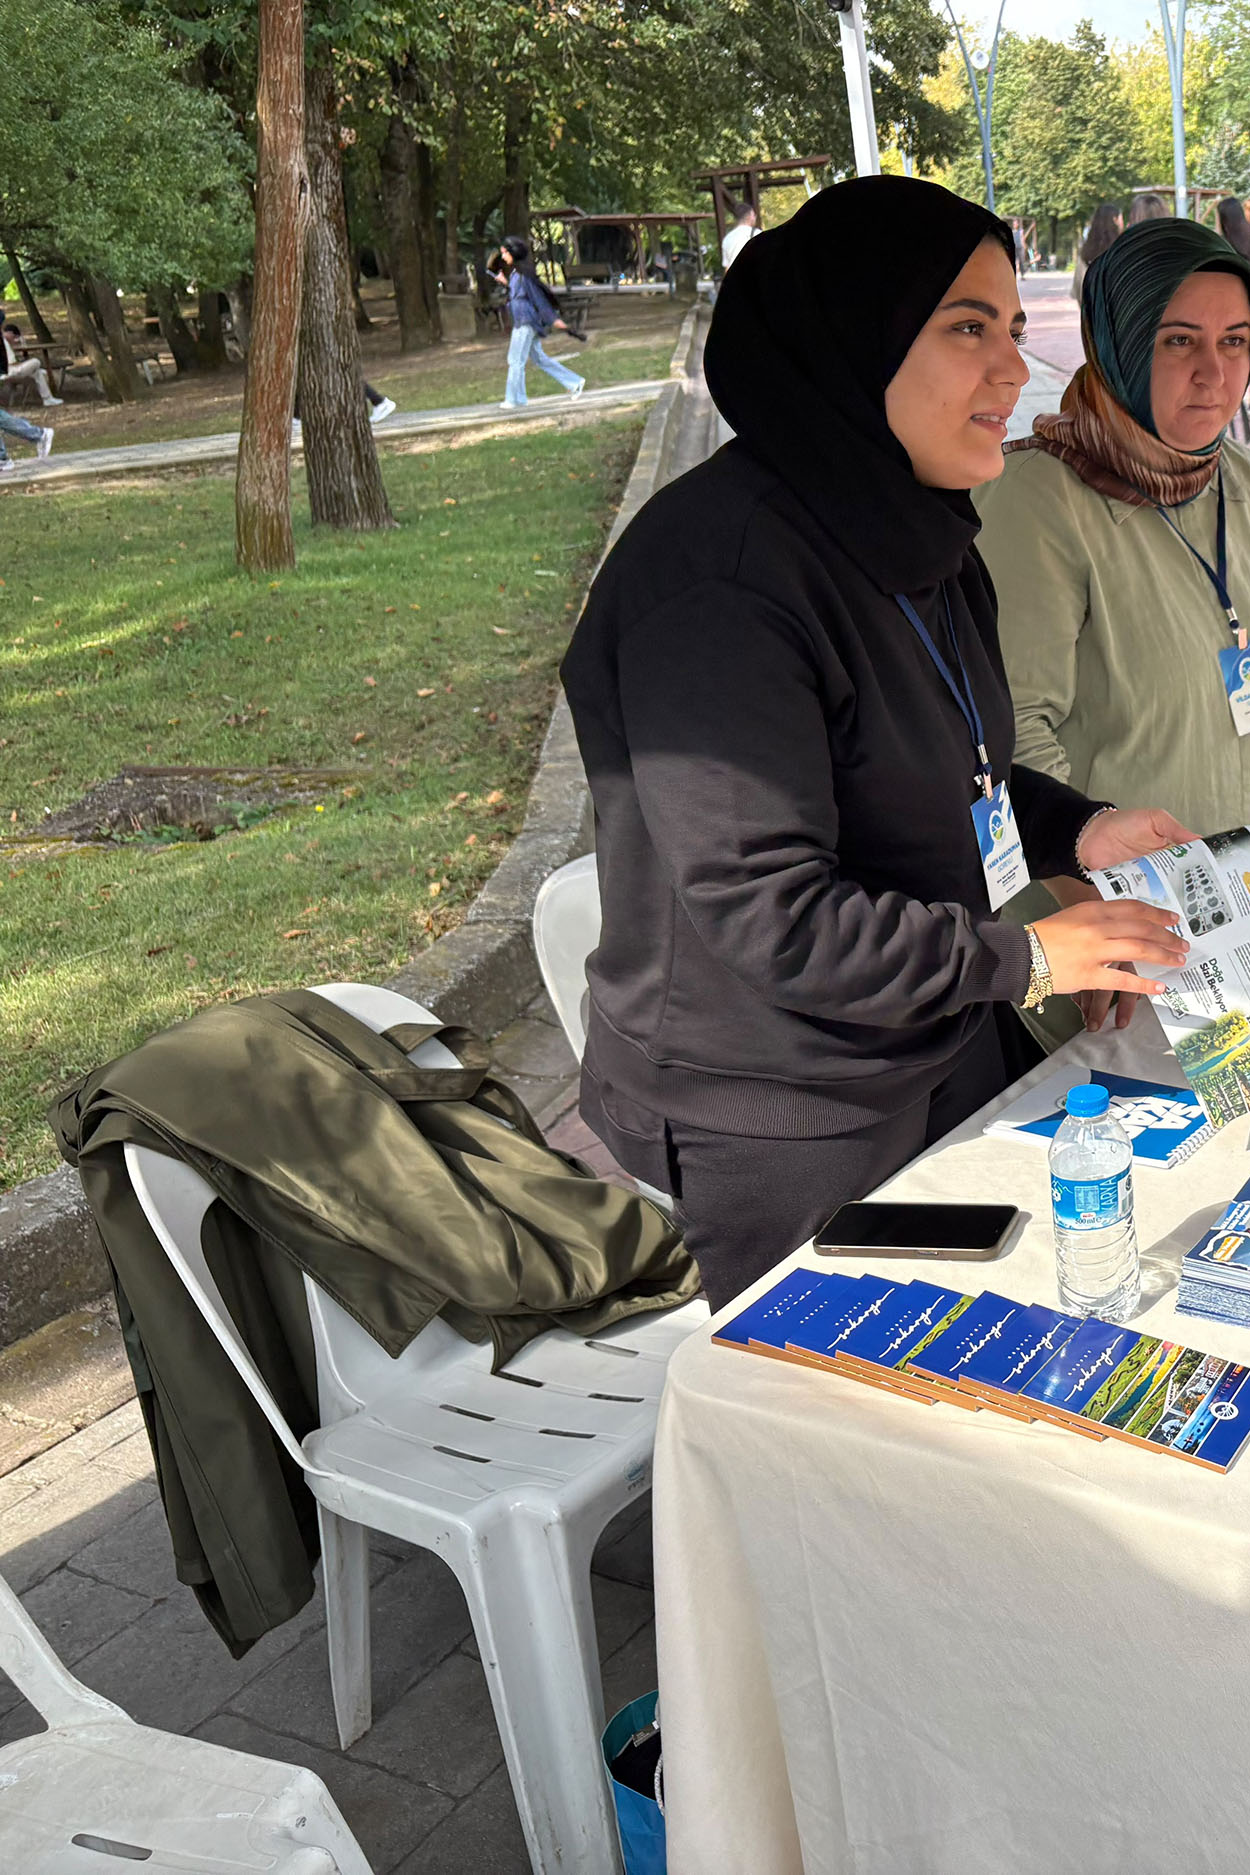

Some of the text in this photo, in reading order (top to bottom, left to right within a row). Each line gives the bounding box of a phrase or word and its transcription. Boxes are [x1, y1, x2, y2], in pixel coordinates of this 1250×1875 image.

[1208, 958, 1224, 982] Doğa
[1200, 962, 1228, 1013] Sizi Bekliyor
[1075, 1217, 1087, 1225] 500
